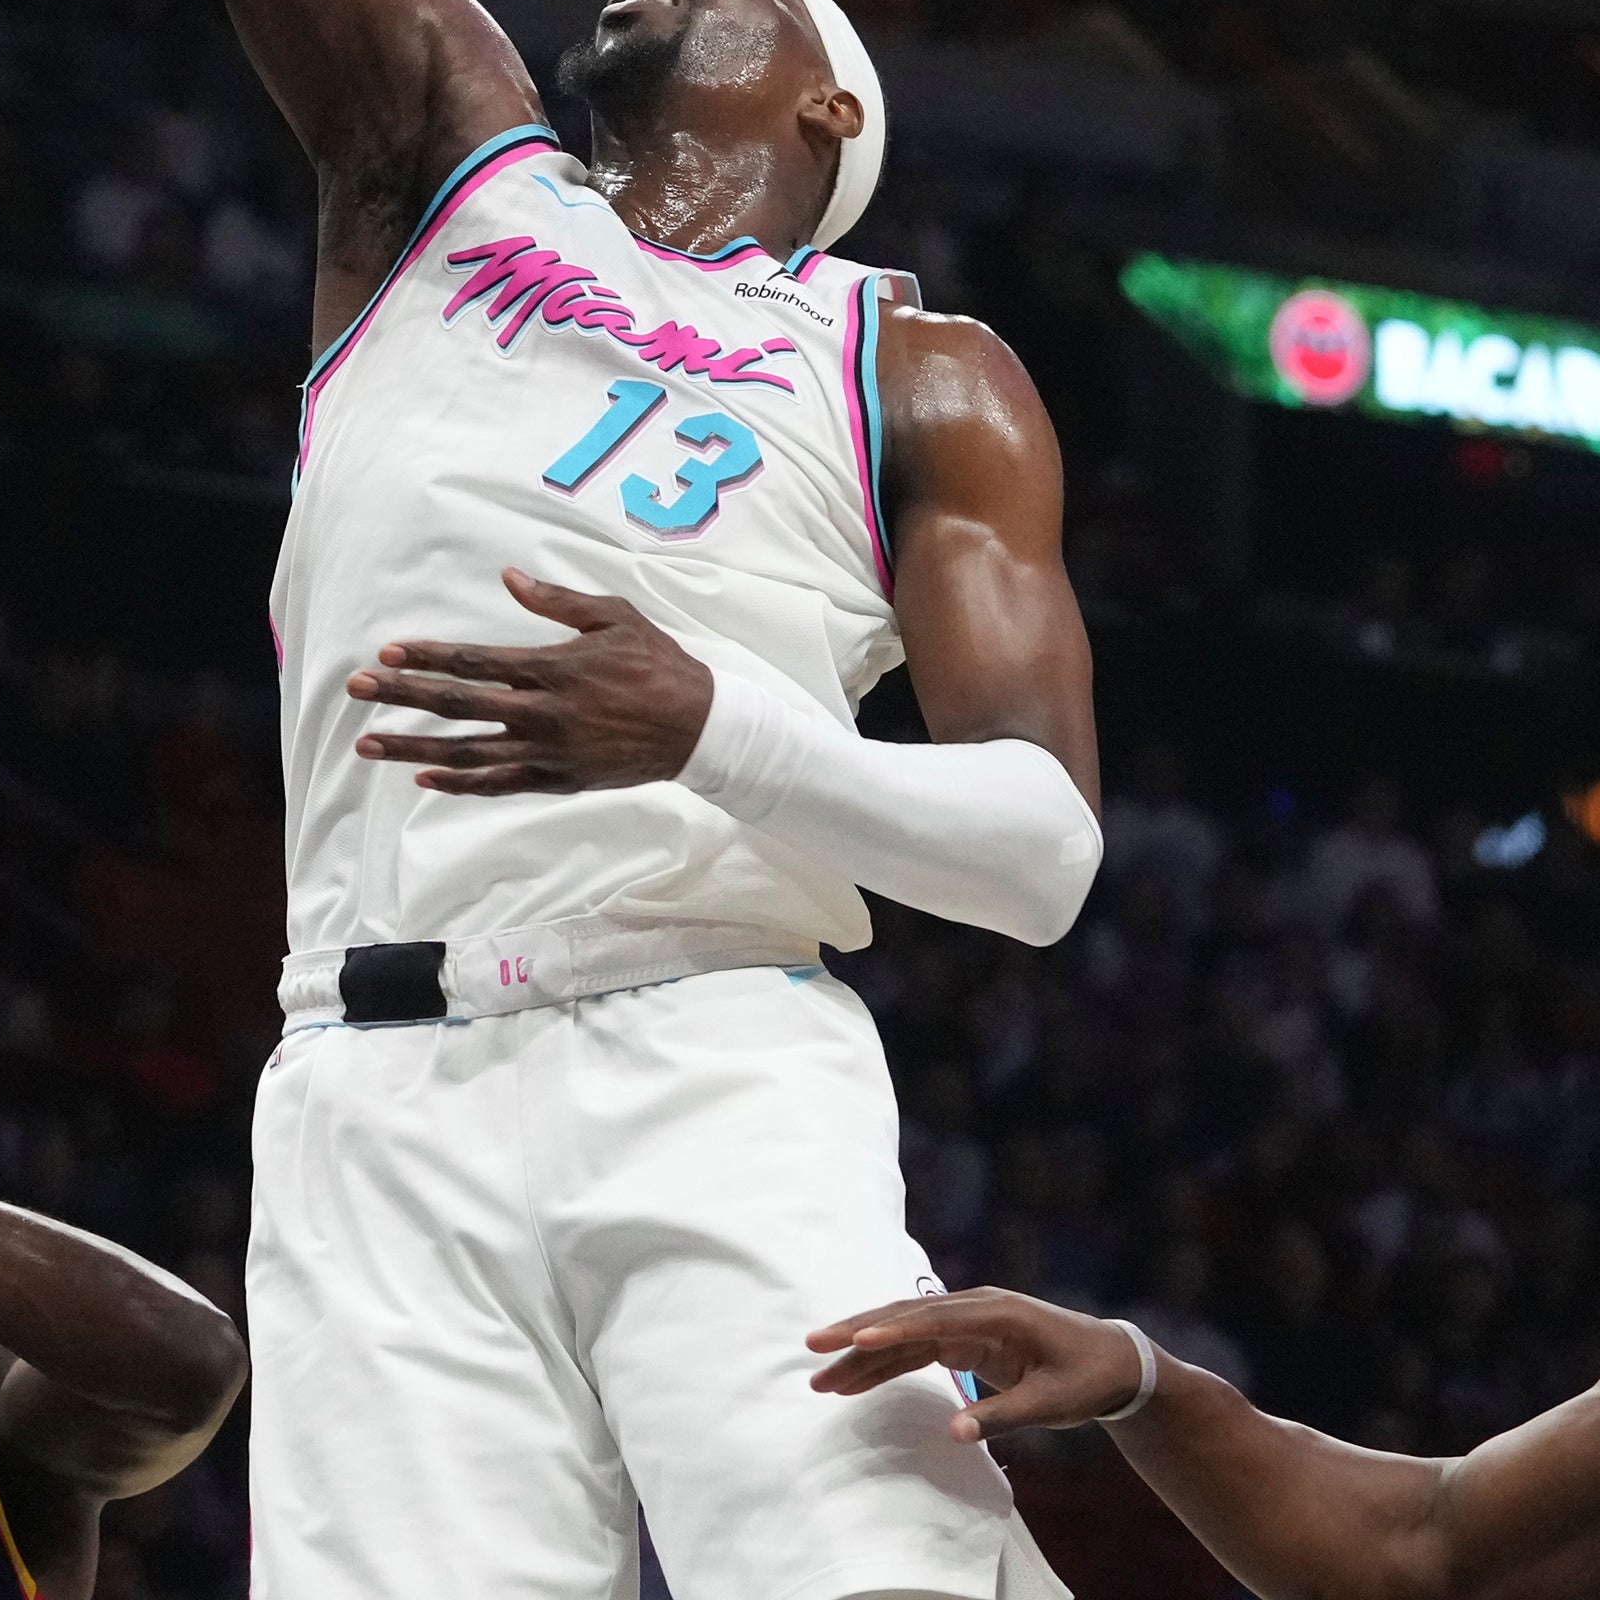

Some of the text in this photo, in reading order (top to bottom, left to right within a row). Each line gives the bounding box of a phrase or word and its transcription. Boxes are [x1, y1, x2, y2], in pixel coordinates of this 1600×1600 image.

[442, 235, 798, 399] Miami
[734, 282, 834, 328] Robinhood
[541, 378, 766, 541] 13
